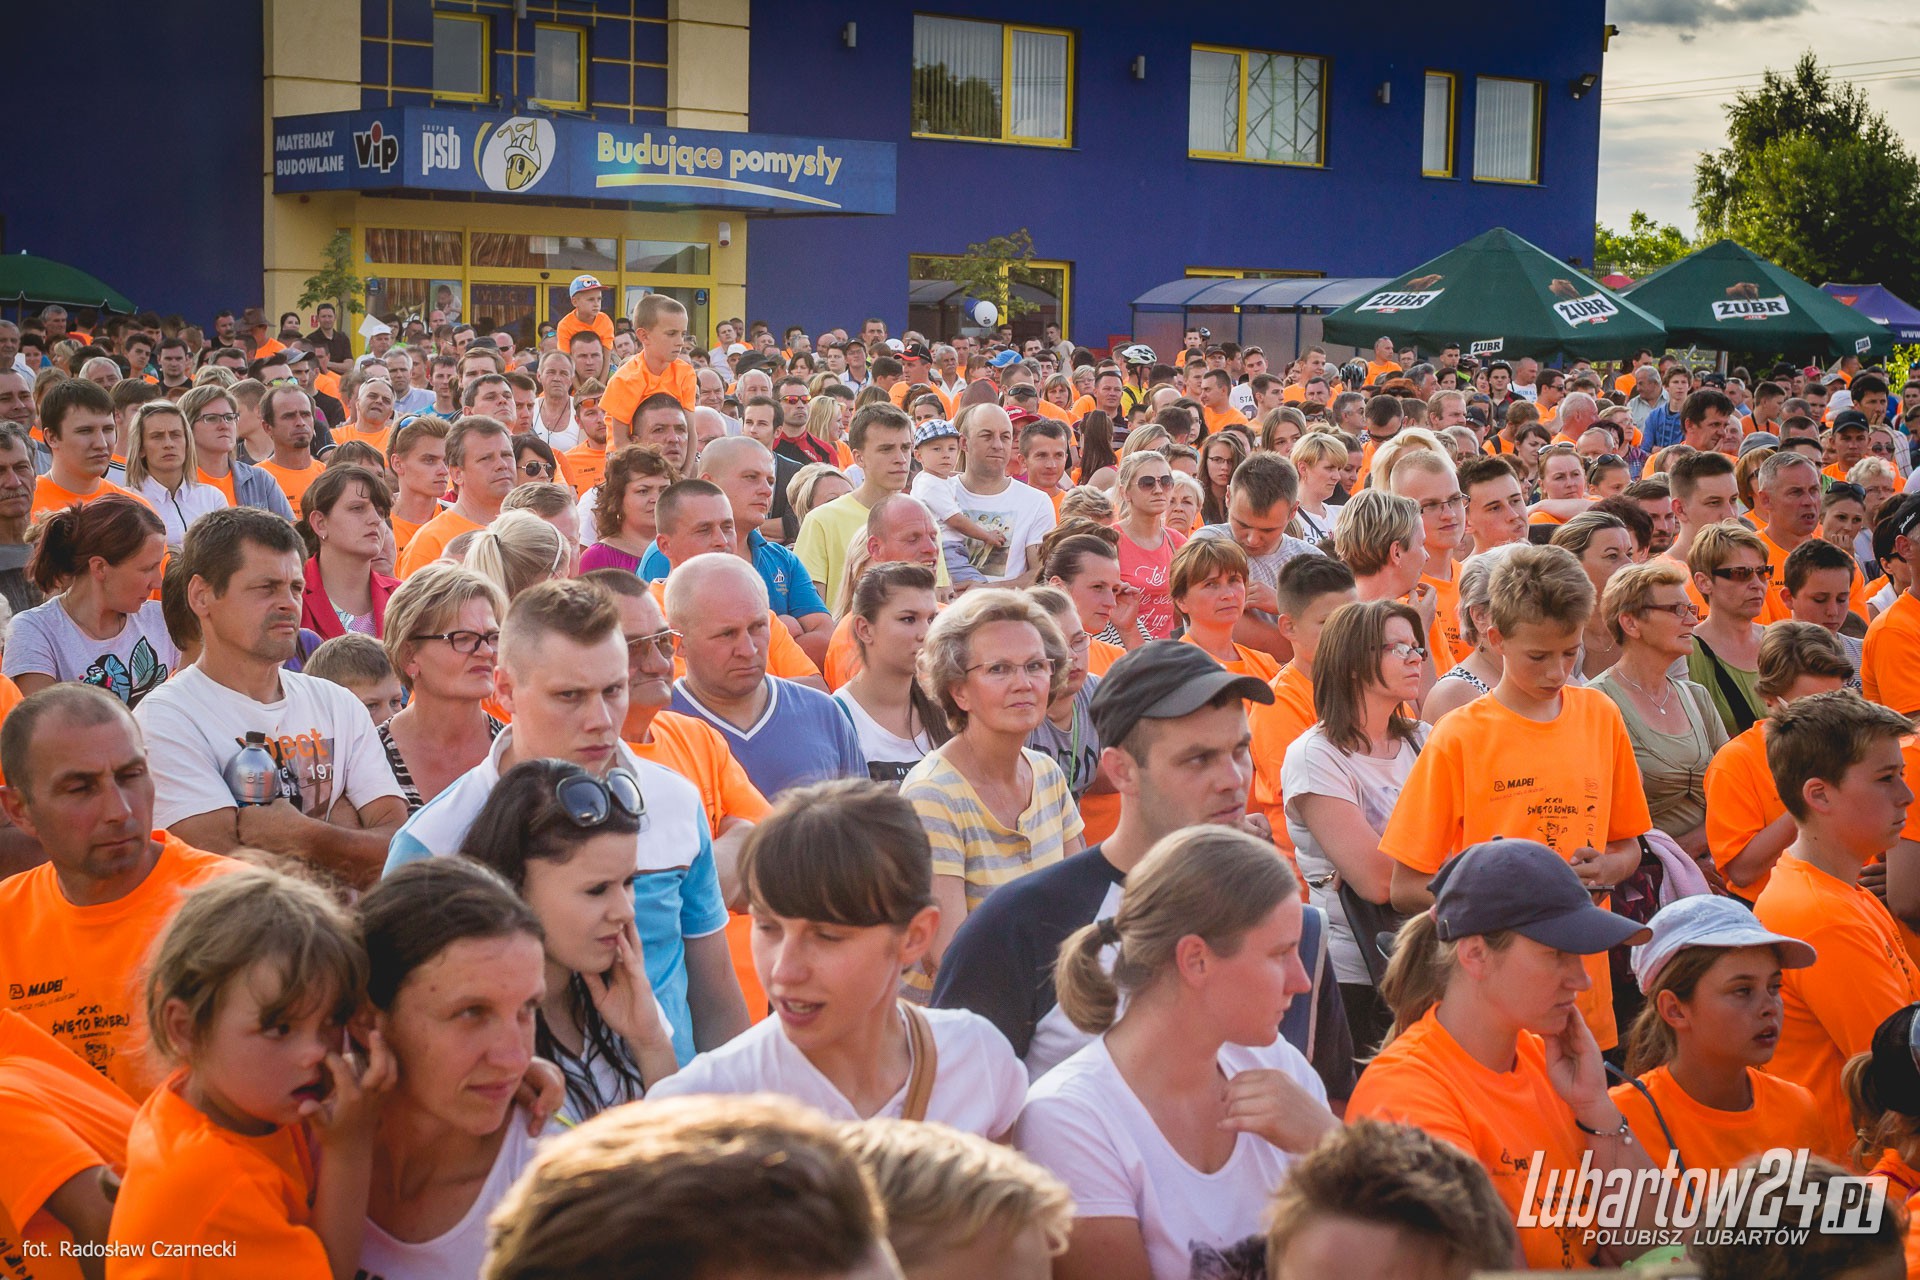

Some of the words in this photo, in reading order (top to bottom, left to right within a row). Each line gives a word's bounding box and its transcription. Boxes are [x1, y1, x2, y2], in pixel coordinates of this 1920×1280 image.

[276, 130, 335, 152] MATERIAŁY
[422, 126, 460, 175] psb
[276, 155, 344, 176] BUDOWLANE
[597, 131, 722, 175] Budujące
[730, 146, 842, 185] pomysły
[1507, 777, 1535, 789] MAPEI
[28, 979, 63, 998] MAPEI
